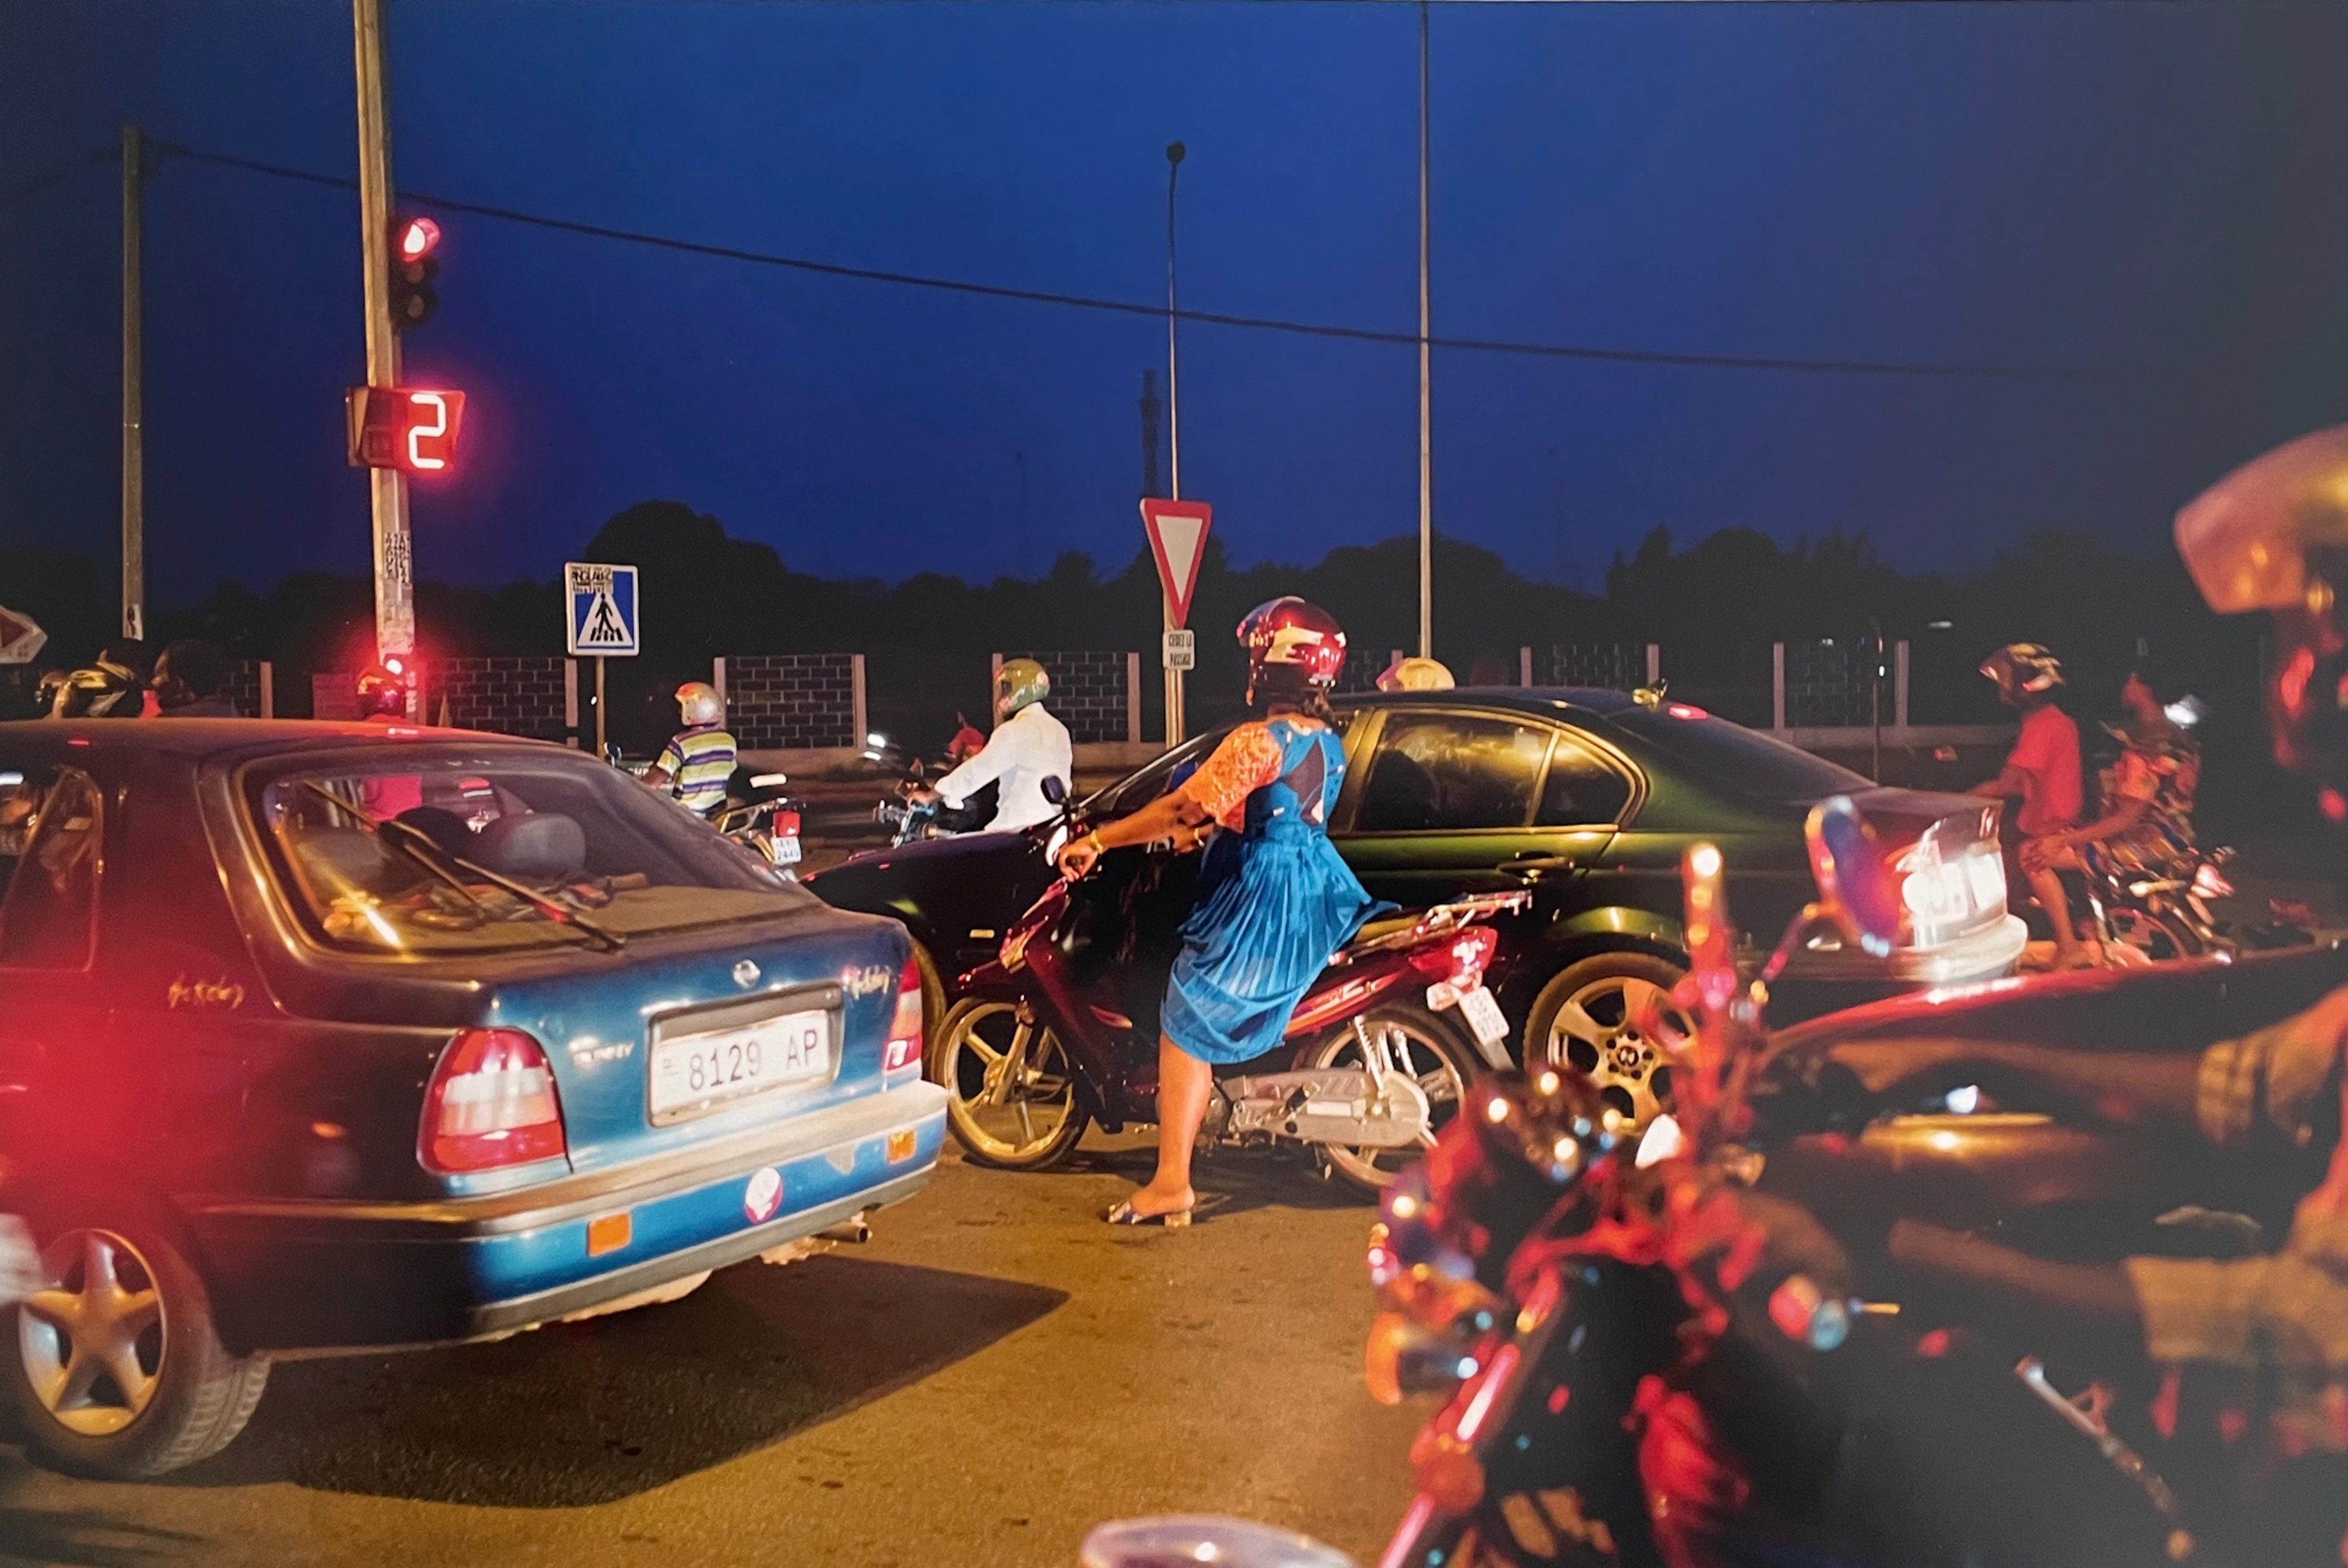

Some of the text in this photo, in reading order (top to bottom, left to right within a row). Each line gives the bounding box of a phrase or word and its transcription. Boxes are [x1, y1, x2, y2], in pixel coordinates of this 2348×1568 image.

[408, 393, 446, 469] 2
[689, 1029, 818, 1091] 8129 AP
